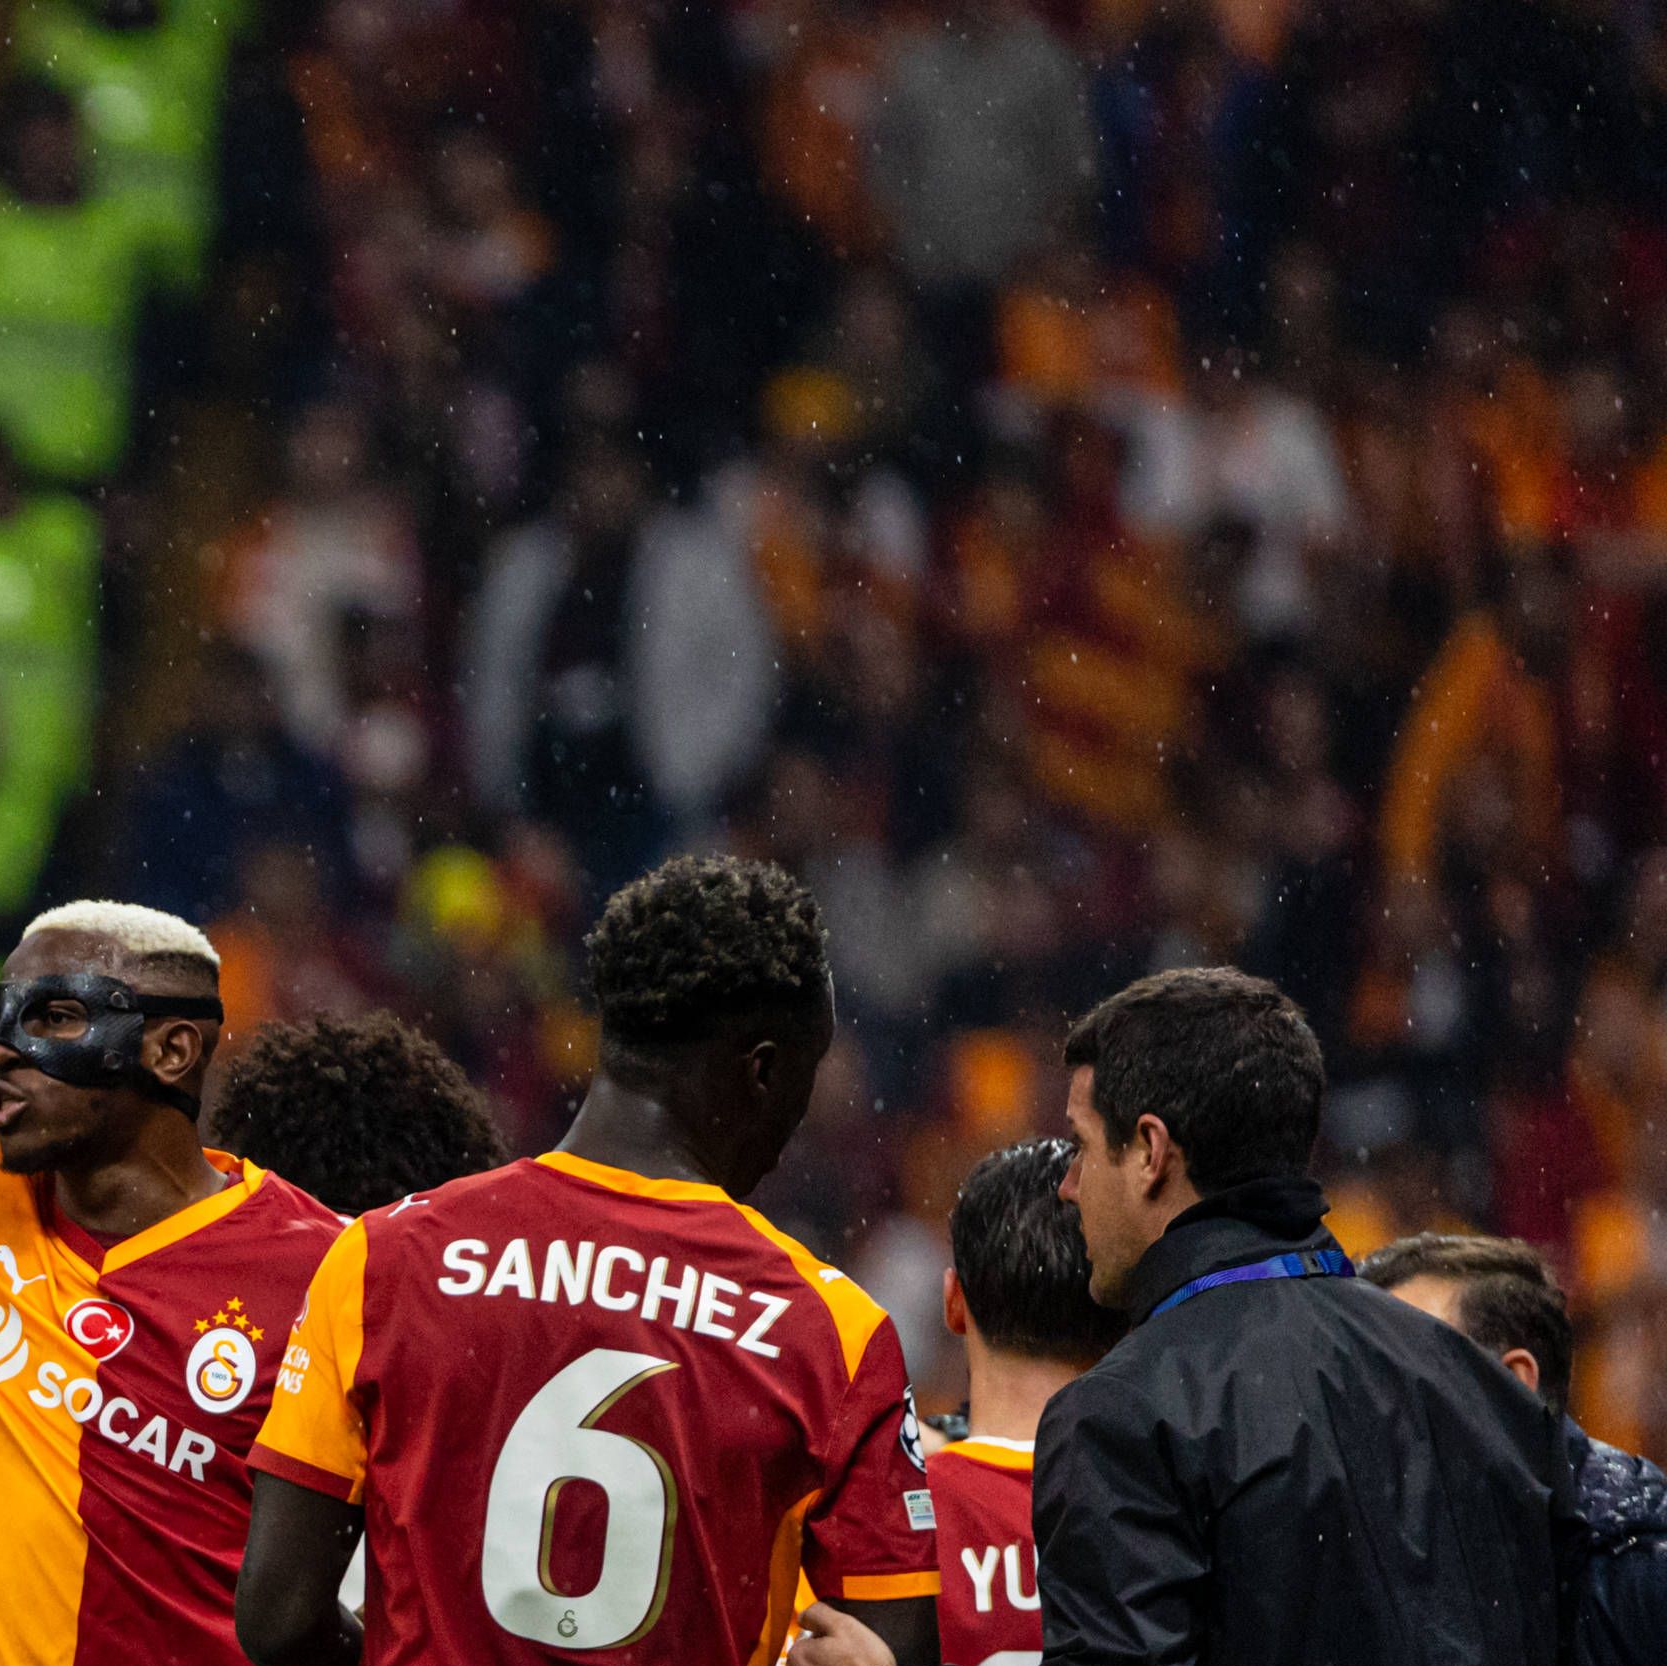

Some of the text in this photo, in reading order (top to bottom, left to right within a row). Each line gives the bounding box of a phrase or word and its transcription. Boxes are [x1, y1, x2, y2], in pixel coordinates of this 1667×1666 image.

[437, 1237, 792, 1358] SANCHEZ
[28, 1361, 216, 1483] SOCAR
[480, 1347, 681, 1650] 6
